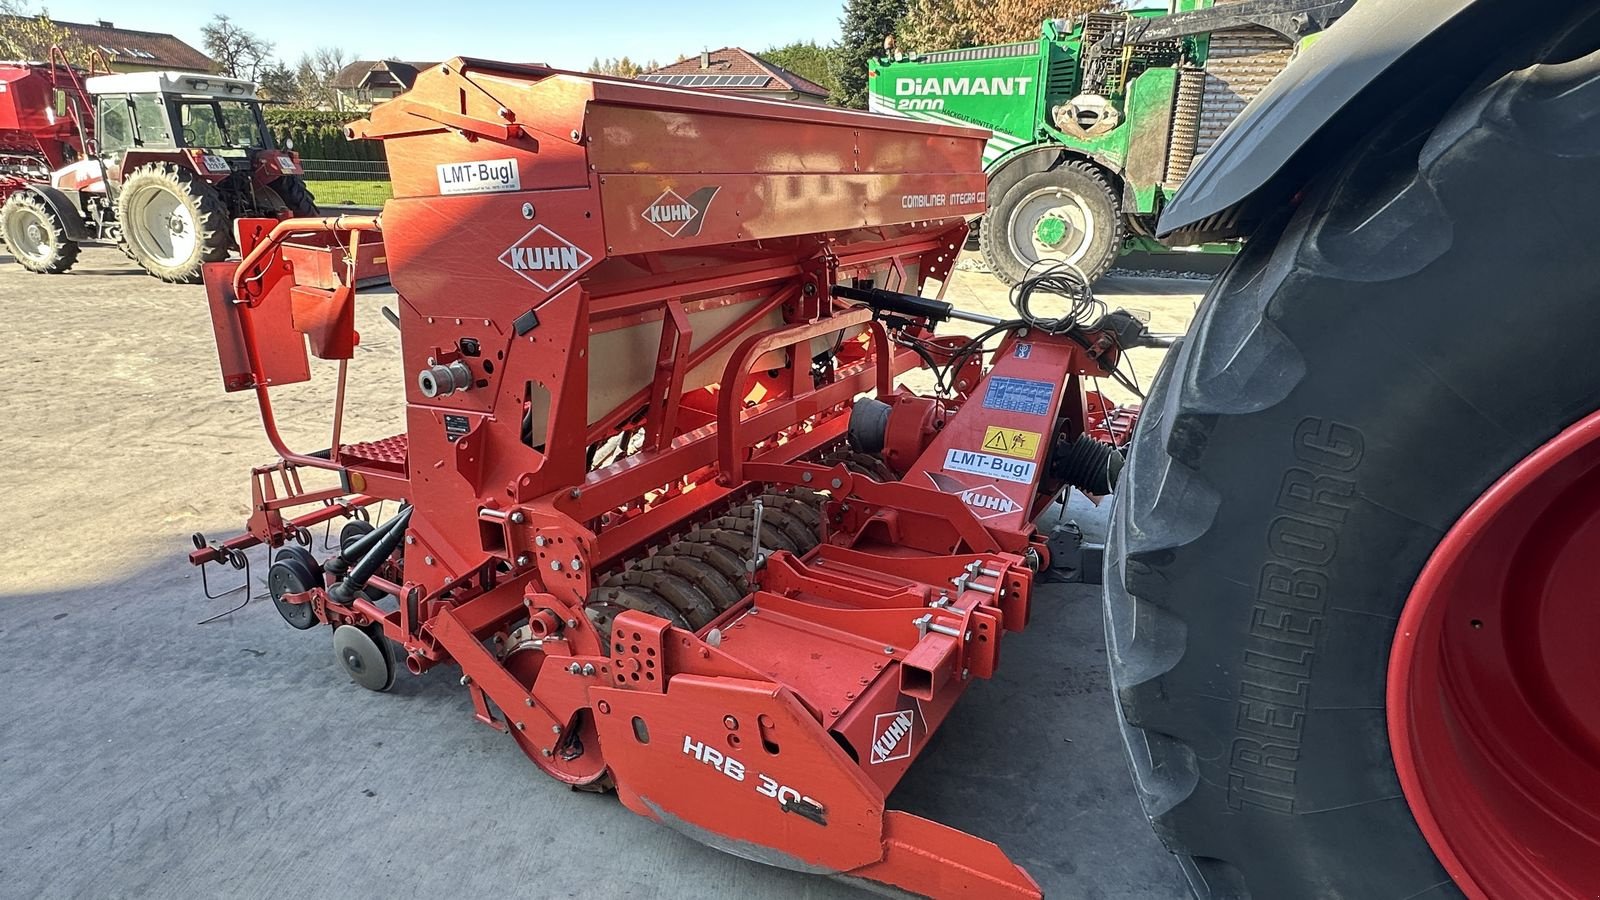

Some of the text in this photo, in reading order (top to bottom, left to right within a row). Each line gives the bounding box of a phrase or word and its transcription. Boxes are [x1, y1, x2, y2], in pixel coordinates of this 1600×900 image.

[896, 77, 1032, 96] DiAMANT
[897, 98, 944, 111] 2000
[941, 108, 1014, 136] HACKGUT WINTER GmbH
[442, 161, 514, 184] LMT-Bugl
[901, 194, 946, 208] COMBILINER
[949, 192, 976, 205] INTEGRA
[650, 204, 692, 223] KUHN
[510, 246, 579, 271] KUHN
[950, 450, 1031, 477] LMT-Bugl
[961, 490, 1014, 513] KUHN
[1227, 415, 1365, 816] TRELLEBORG
[873, 712, 912, 761] KUHN
[682, 735, 746, 782] HRB
